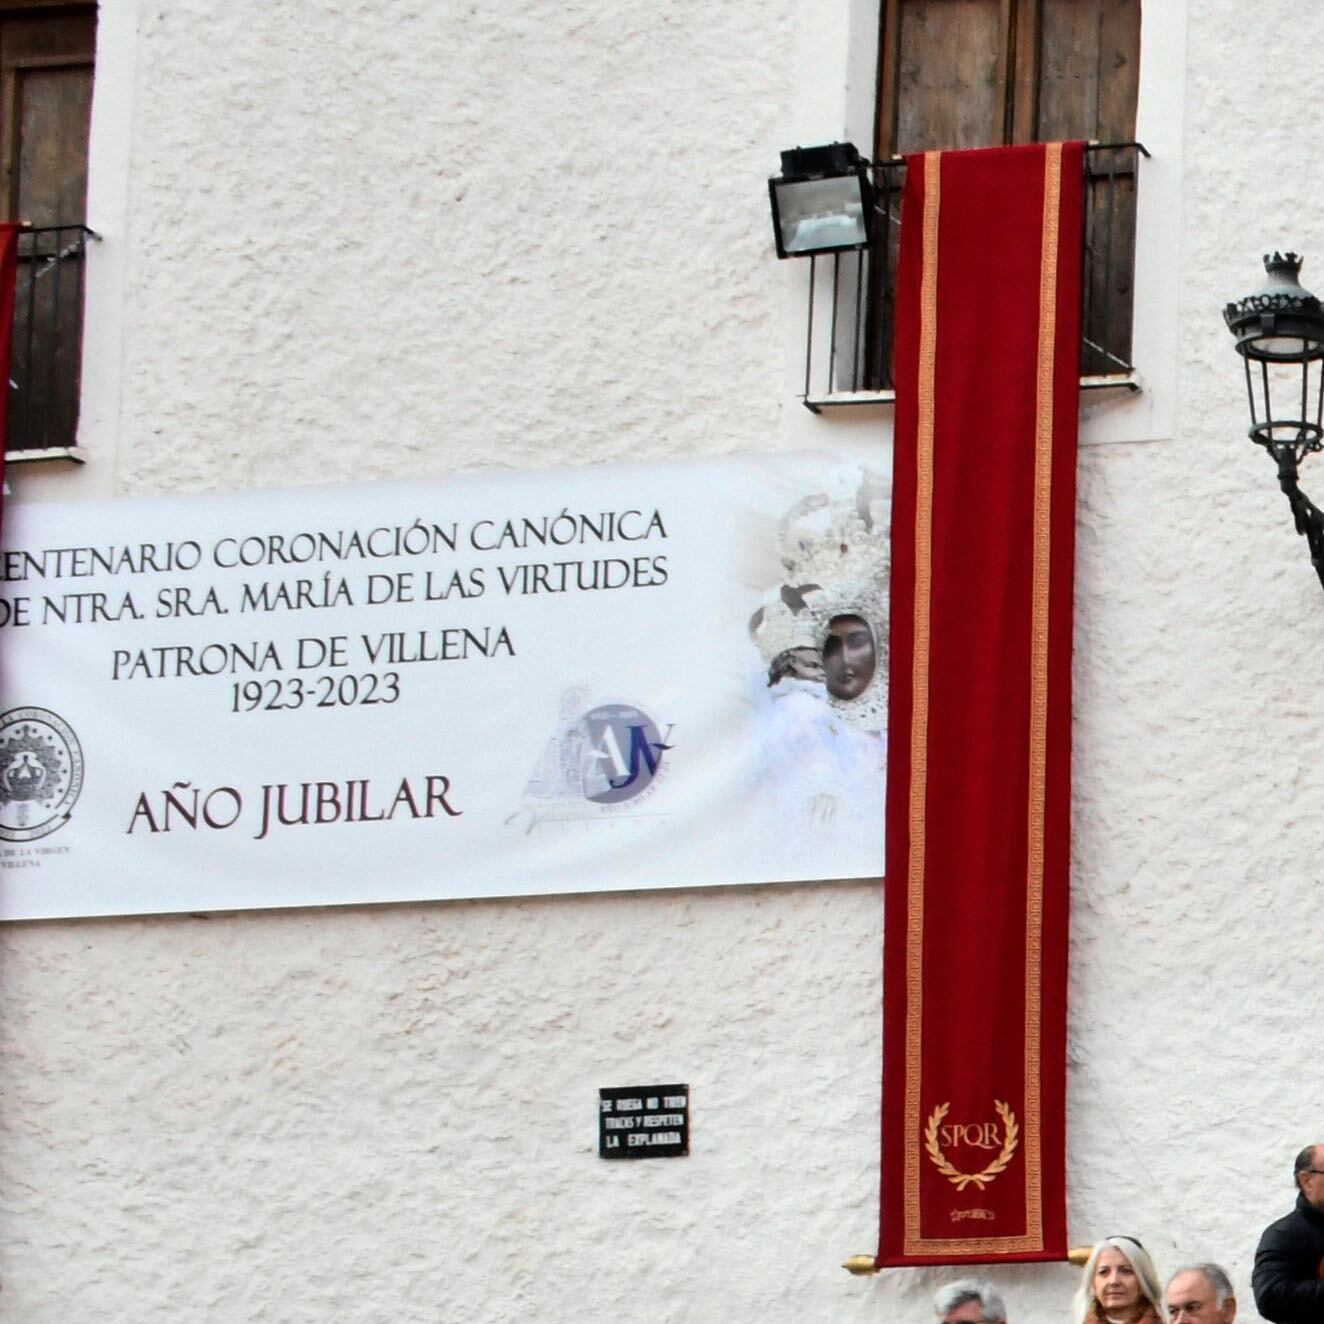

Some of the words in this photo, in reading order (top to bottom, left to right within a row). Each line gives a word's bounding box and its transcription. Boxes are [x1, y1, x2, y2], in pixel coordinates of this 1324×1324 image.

[0, 540, 201, 581] ENTENARIO
[213, 518, 457, 568] CORONACIÓN
[471, 508, 668, 550] CANÓNICA
[42, 592, 145, 625] NTRA.
[156, 586, 229, 618] SRA.
[240, 571, 353, 613] MARÍA
[367, 572, 414, 604] DE
[425, 567, 485, 600] LAS
[497, 555, 668, 595] VIRTUDES
[112, 640, 283, 680] PATRONA
[297, 636, 348, 669] DE
[361, 626, 516, 664] VILLENA
[231, 672, 400, 712] 1923-2023
[126, 780, 242, 834] AÑO
[253, 775, 463, 839] JUBILAR
[606, 1135, 619, 1148] LA
[941, 1122, 1002, 1149] SPQR
